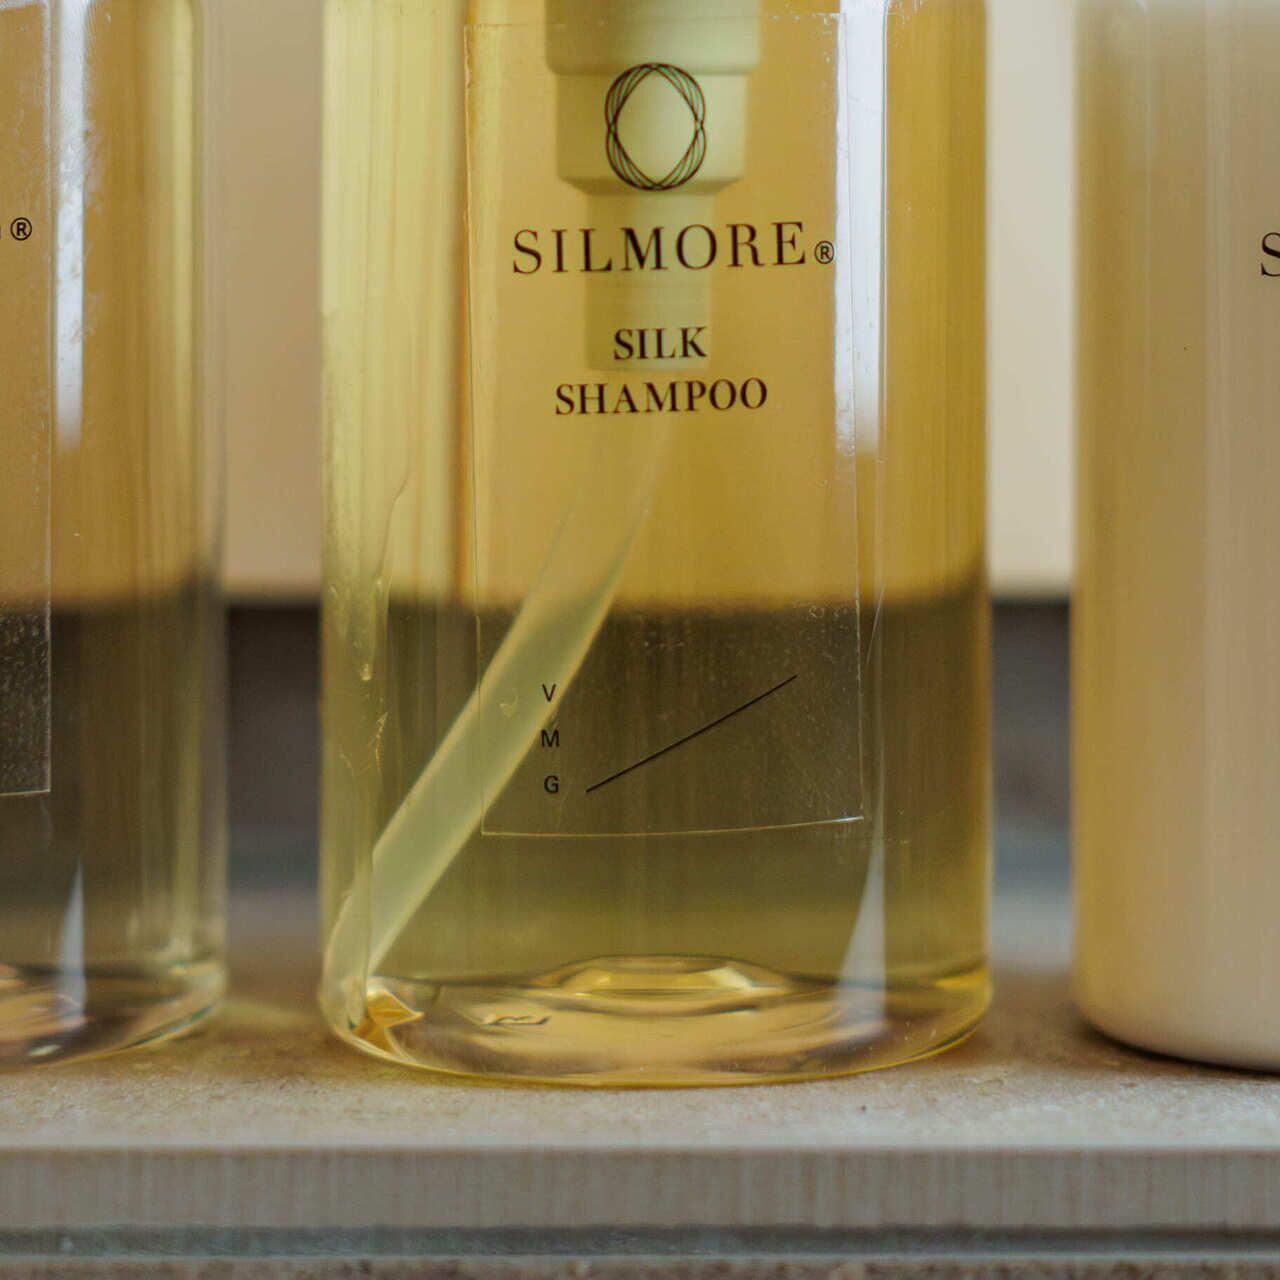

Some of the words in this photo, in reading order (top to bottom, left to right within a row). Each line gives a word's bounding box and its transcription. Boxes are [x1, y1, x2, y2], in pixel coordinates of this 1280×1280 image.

[613, 326, 708, 360] SILK
[554, 377, 769, 416] SHAMPOO
[542, 684, 557, 703] V
[540, 729, 560, 748] M
[543, 775, 560, 794] G
